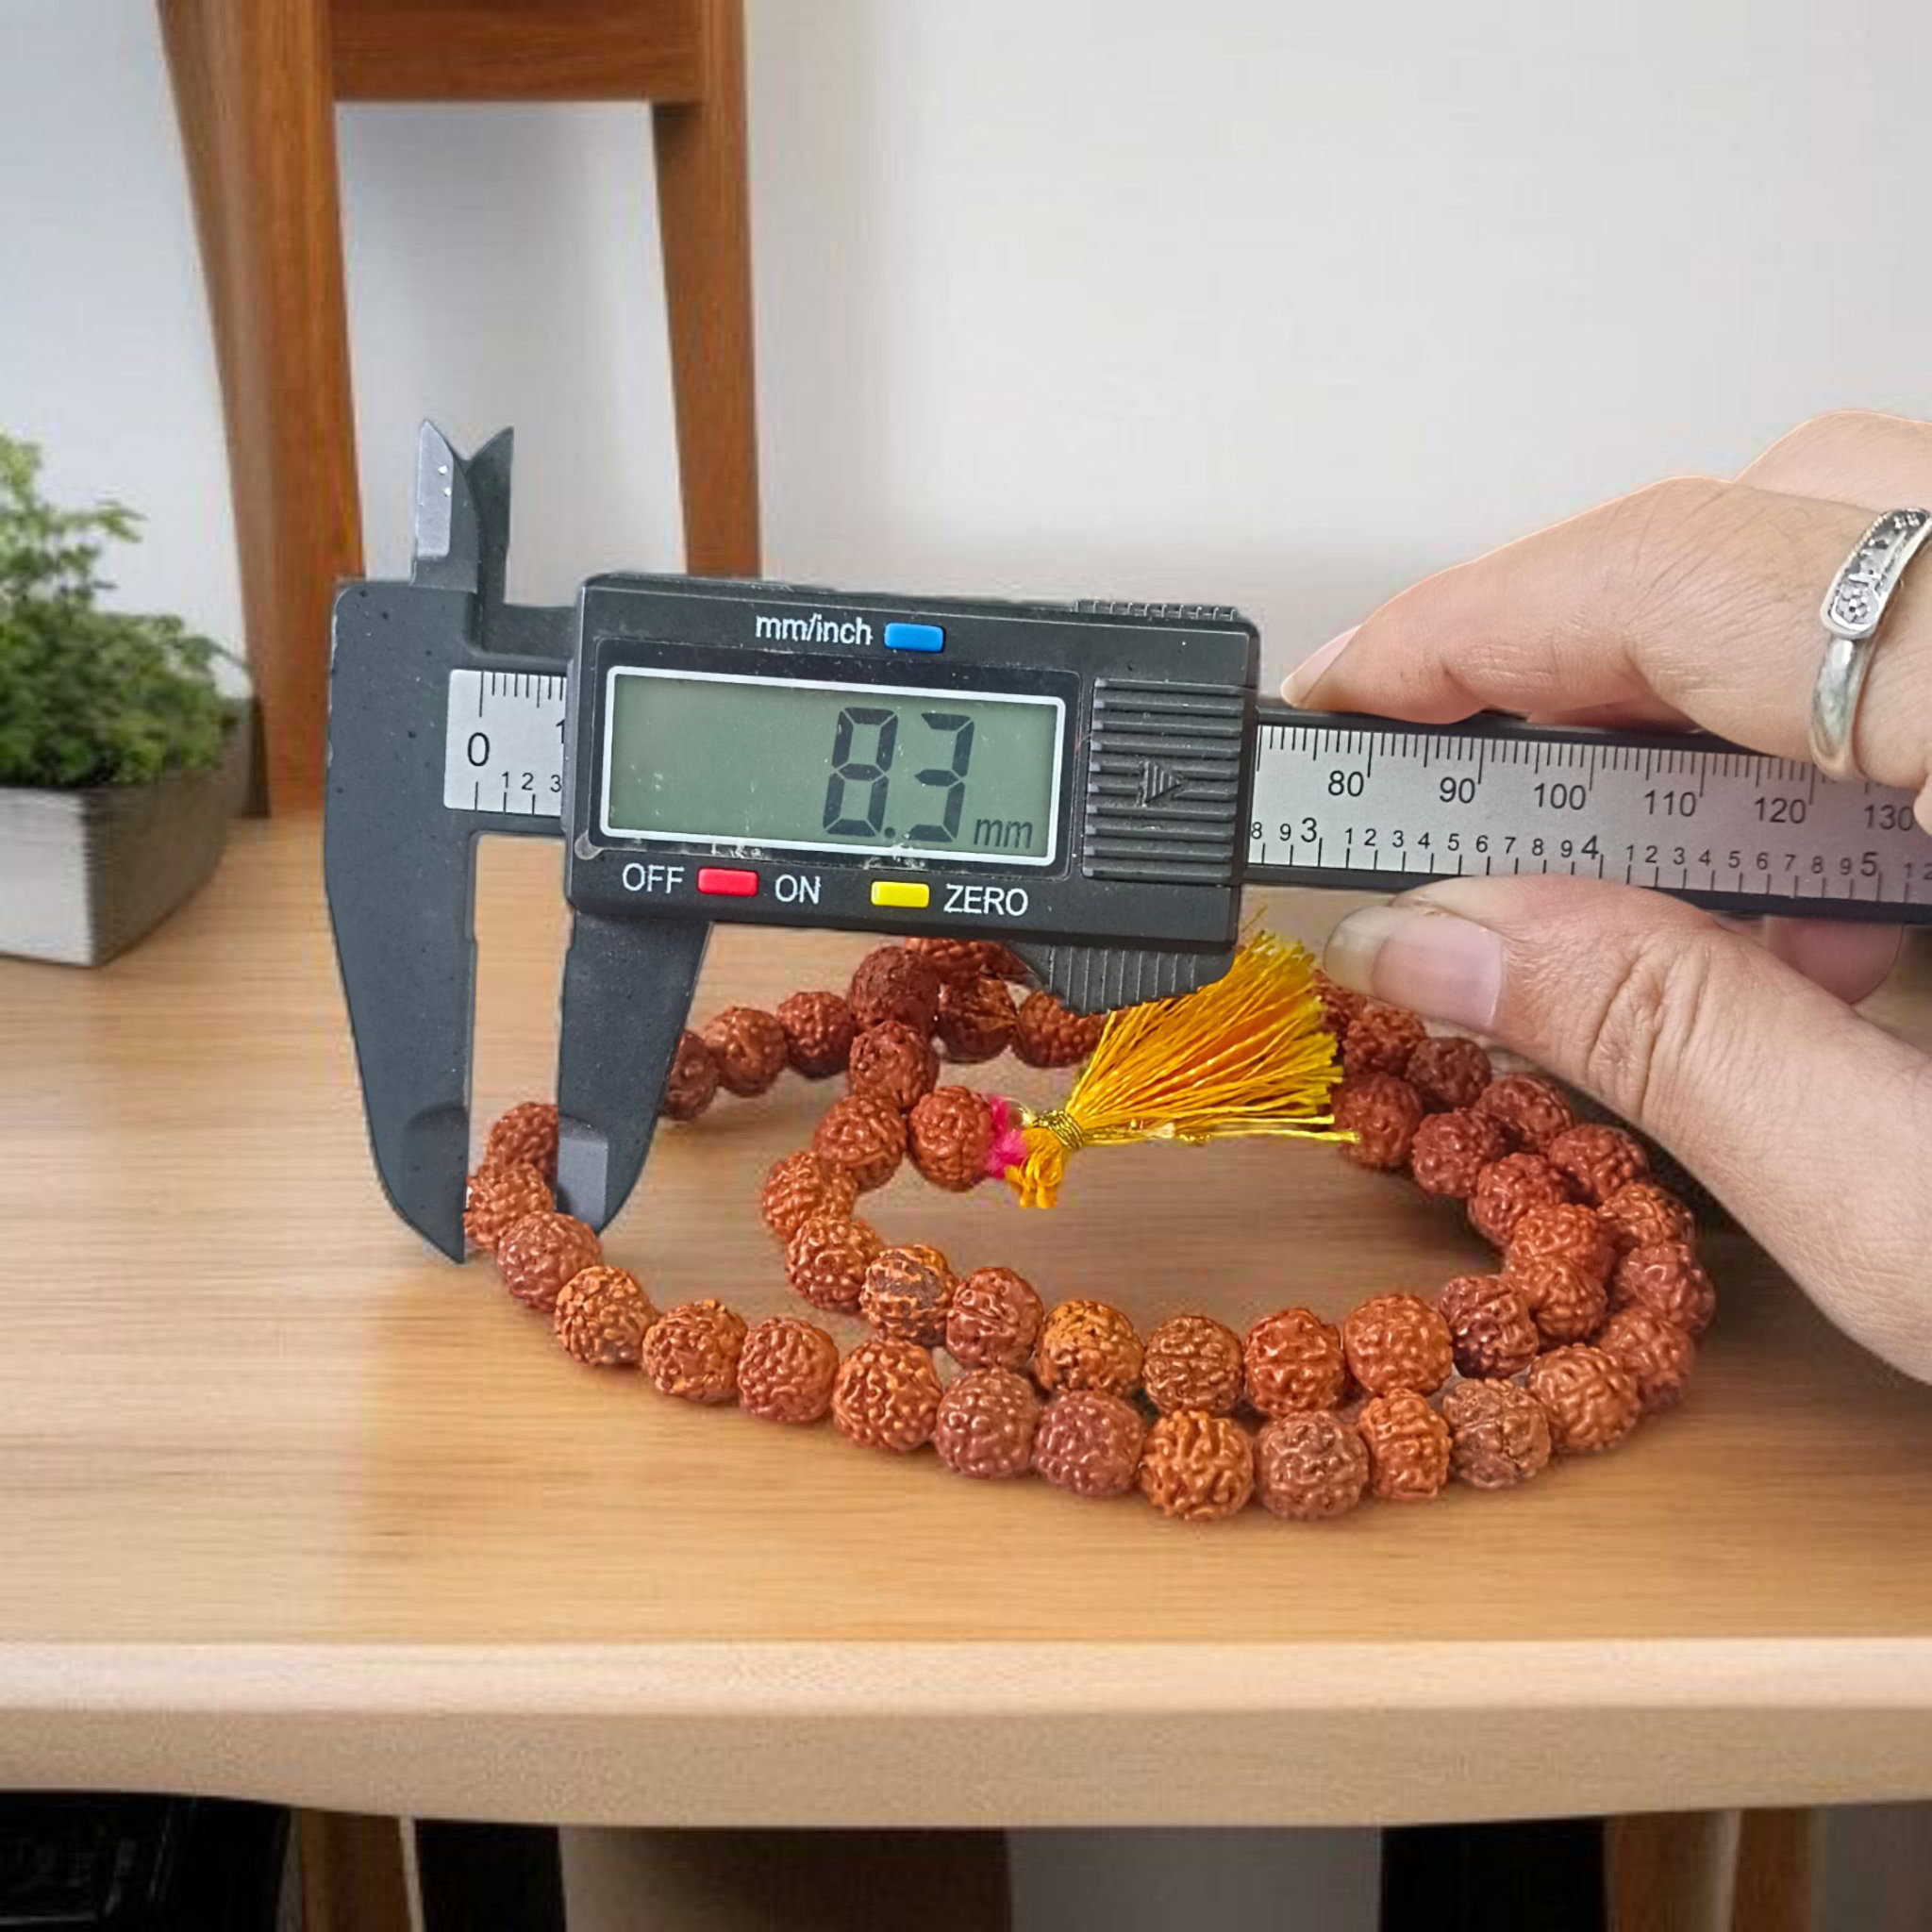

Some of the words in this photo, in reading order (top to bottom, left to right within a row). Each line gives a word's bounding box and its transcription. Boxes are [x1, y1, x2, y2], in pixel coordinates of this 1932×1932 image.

[756, 613, 872, 645] mm/inch
[467, 732, 490, 766] 0
[556, 719, 565, 744] 1
[502, 772, 509, 789] 1
[521, 773, 534, 791] 2
[550, 774, 562, 792] 3
[823, 707, 974, 842] 8.3
[974, 819, 1033, 849] mm
[1327, 770, 1364, 797] 80
[1439, 776, 1475, 804] 90
[1534, 782, 1586, 810] 100
[1644, 790, 1696, 817] 110
[1755, 796, 1806, 824] 120
[1864, 804, 1914, 831] 130
[1251, 822, 1262, 840] 8
[1279, 824, 1291, 841] 9
[1301, 817, 1317, 842] 3
[1344, 827, 1353, 844] 1
[1364, 828, 1376, 846] 2
[1392, 830, 1404, 847] 3
[1418, 832, 1430, 849] 4
[1447, 833, 1459, 851] 5
[1475, 835, 1489, 853] 6
[1505, 837, 1516, 854] 7
[1532, 839, 1543, 856] 8
[1560, 840, 1573, 858] 9
[1581, 835, 1599, 859] 4
[1626, 844, 1634, 861] 1
[1645, 845, 1657, 863] 2
[1673, 847, 1685, 865] 3
[1699, 849, 1711, 866] 4
[1727, 851, 1740, 868] 5
[1757, 852, 1769, 870] 6
[1785, 854, 1796, 872] 7
[1811, 856, 1824, 874] 8
[1840, 858, 1852, 875] 9
[1860, 852, 1878, 876] 5
[1904, 862, 1912, 879] 1
[622, 862, 685, 894] OFF
[774, 874, 821, 905] ON
[943, 883, 1028, 916] ZERO
